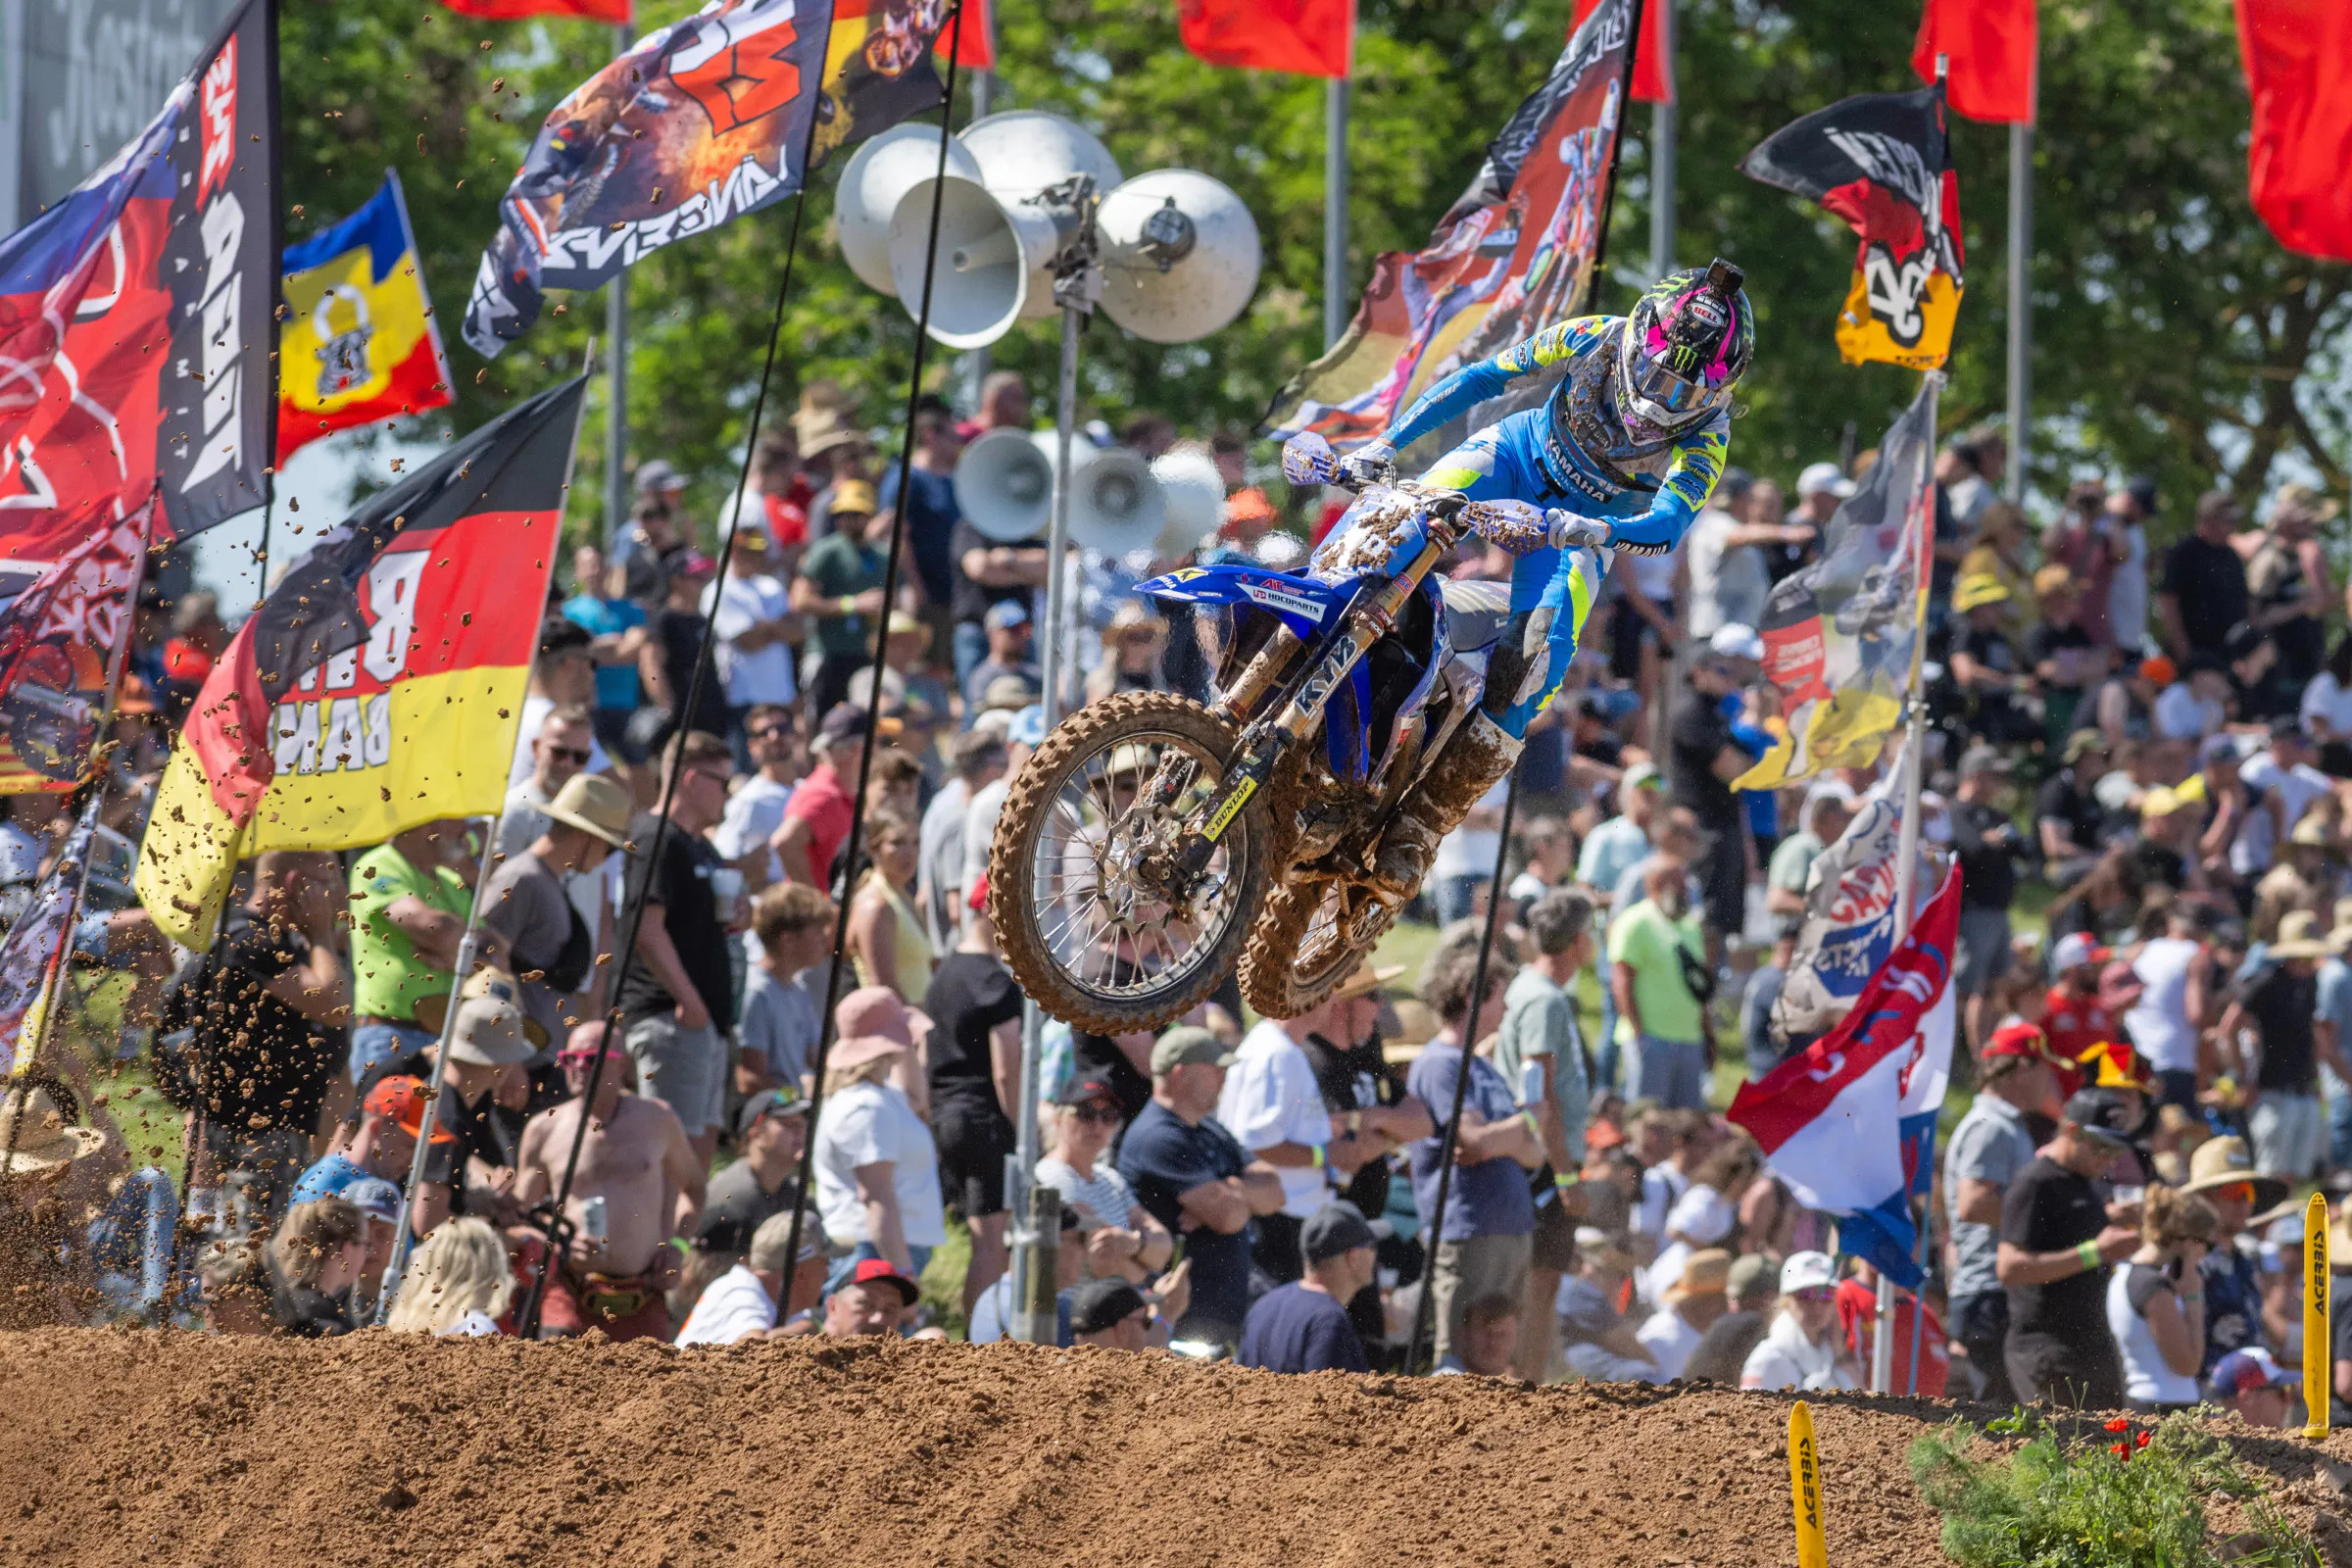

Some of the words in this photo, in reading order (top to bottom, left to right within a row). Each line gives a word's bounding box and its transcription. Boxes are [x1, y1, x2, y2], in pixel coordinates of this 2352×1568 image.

[1693, 306, 1718, 323] BELL
[1548, 434, 1605, 502] YAMAHA
[1268, 593, 1319, 613] HOCOPARTS
[1295, 636, 1357, 717] KYB
[1214, 780, 1250, 827] DUNLOP
